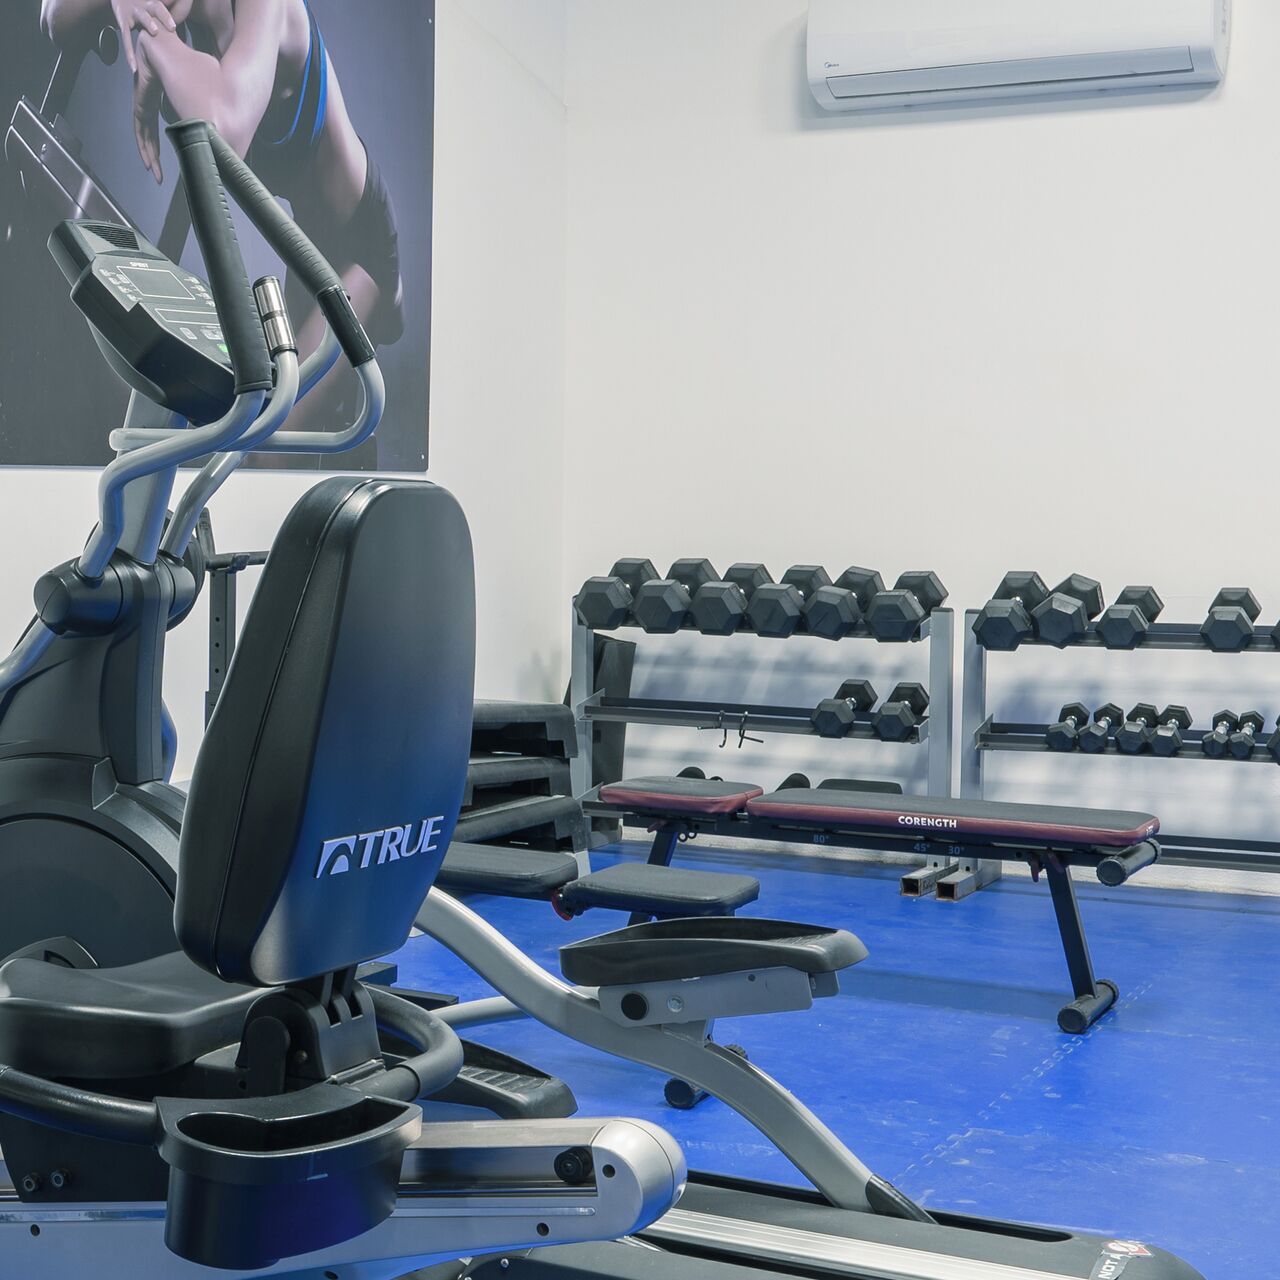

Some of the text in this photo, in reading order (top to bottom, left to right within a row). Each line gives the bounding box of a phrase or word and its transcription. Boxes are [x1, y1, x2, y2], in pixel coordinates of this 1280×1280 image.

[898, 816, 957, 828] CORENGTH
[359, 815, 445, 869] TRUE
[813, 834, 965, 856] 80° 45° 30°
[1098, 1259, 1118, 1279] NOT
